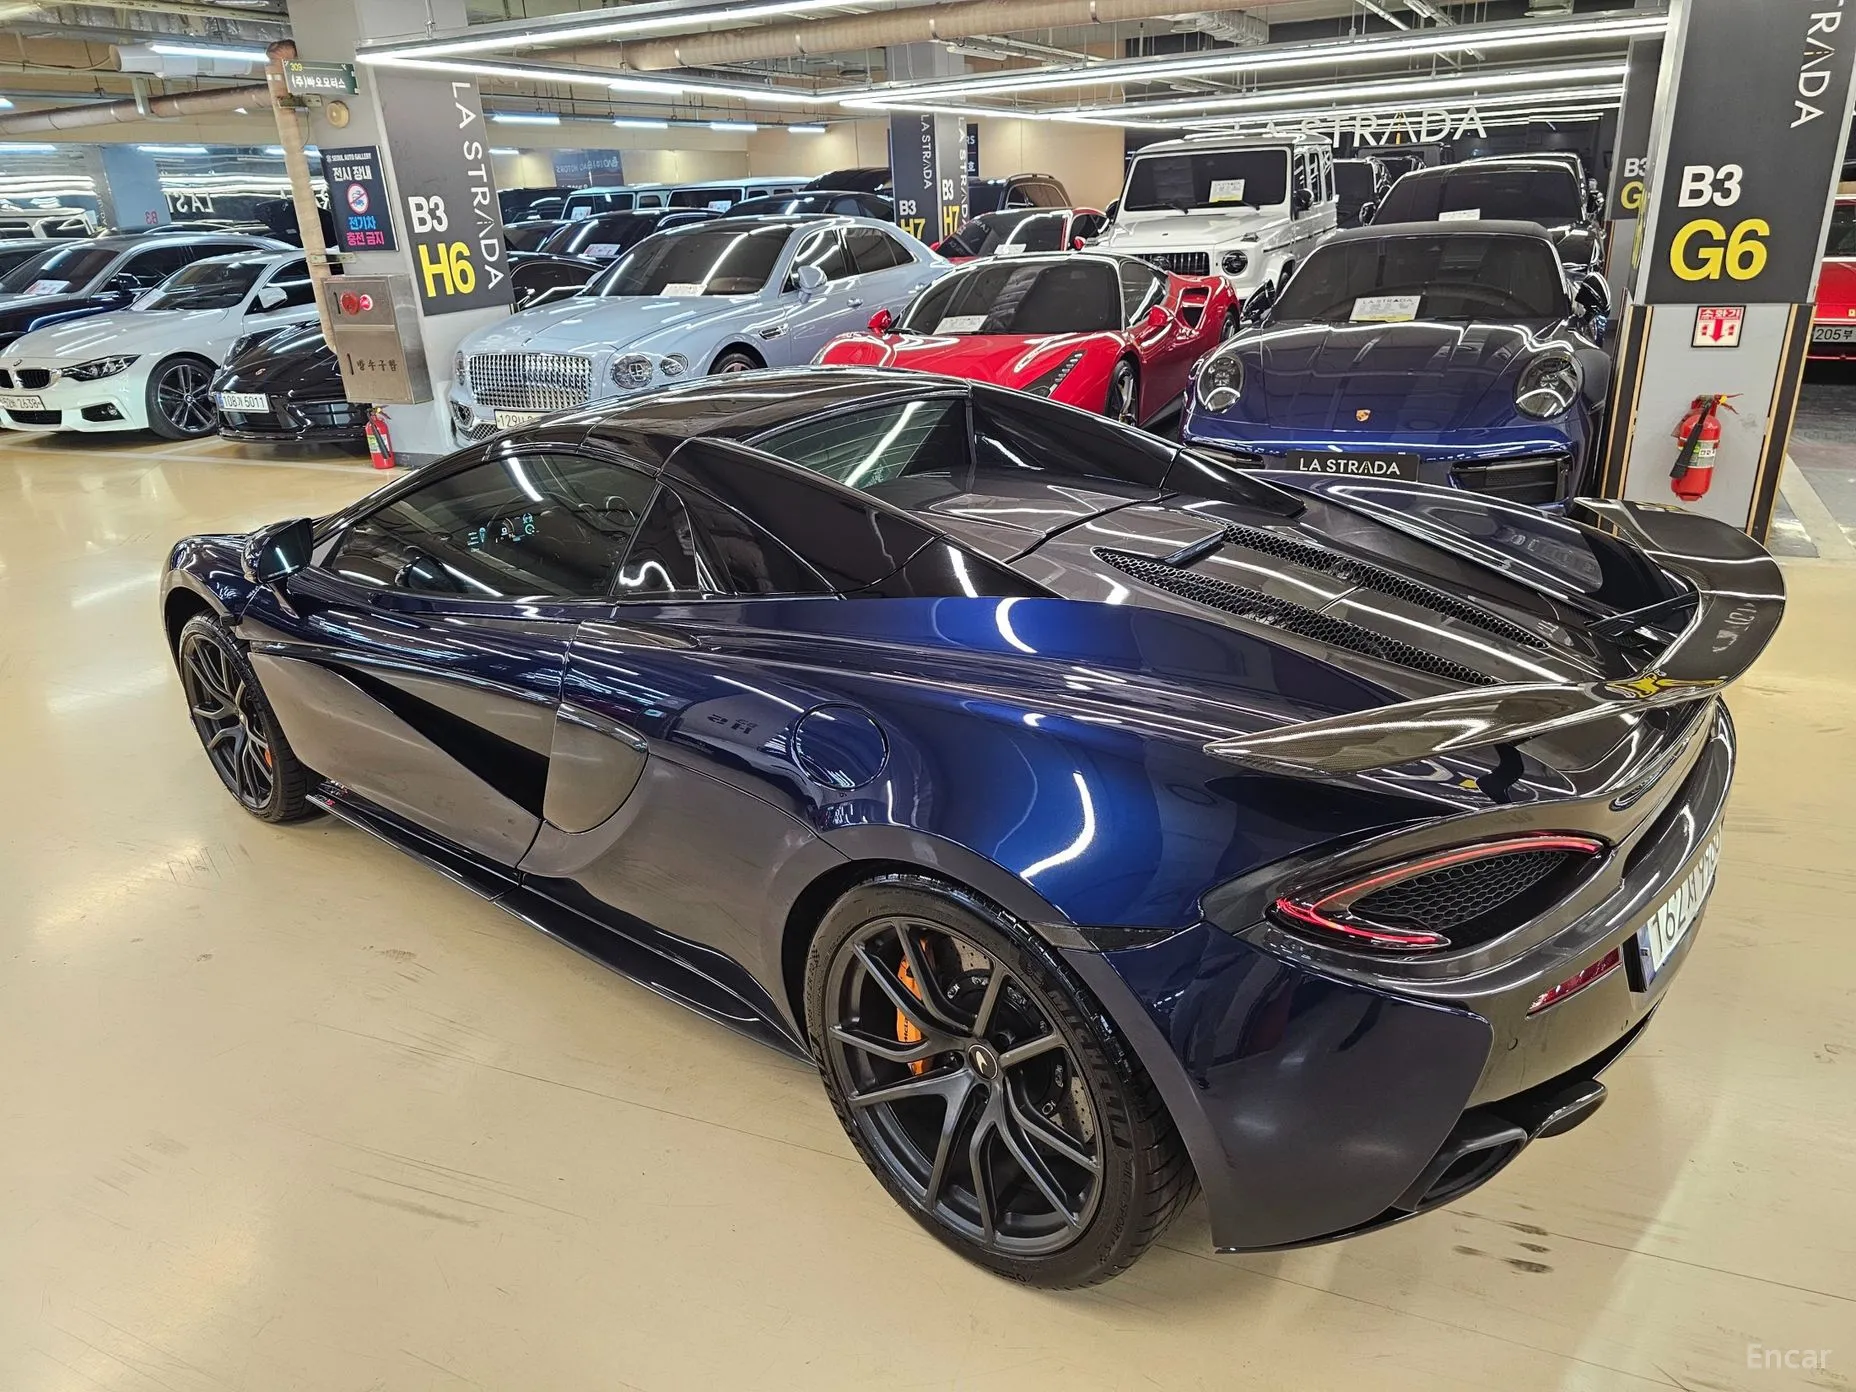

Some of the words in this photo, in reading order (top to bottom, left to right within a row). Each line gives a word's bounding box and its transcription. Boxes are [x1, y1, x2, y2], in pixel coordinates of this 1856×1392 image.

[1790, 0, 1843, 128] RADA
[451, 81, 477, 129] LA
[332, 166, 353, 182] 전시
[352, 165, 373, 181] 장내
[921, 134, 933, 190] STRADA
[942, 179, 954, 201] B3
[1678, 164, 1743, 208] B3
[348, 215, 377, 231] 전기차
[408, 195, 449, 234] B3
[463, 140, 505, 290] STRADA
[899, 200, 917, 216] B3
[943, 205, 961, 237] H7
[346, 231, 366, 246] 충전
[366, 230, 385, 245] 금지
[1669, 218, 1771, 282] G6
[418, 241, 477, 298] H6
[1299, 457, 1322, 472] LA
[1326, 459, 1400, 475] STRADA
